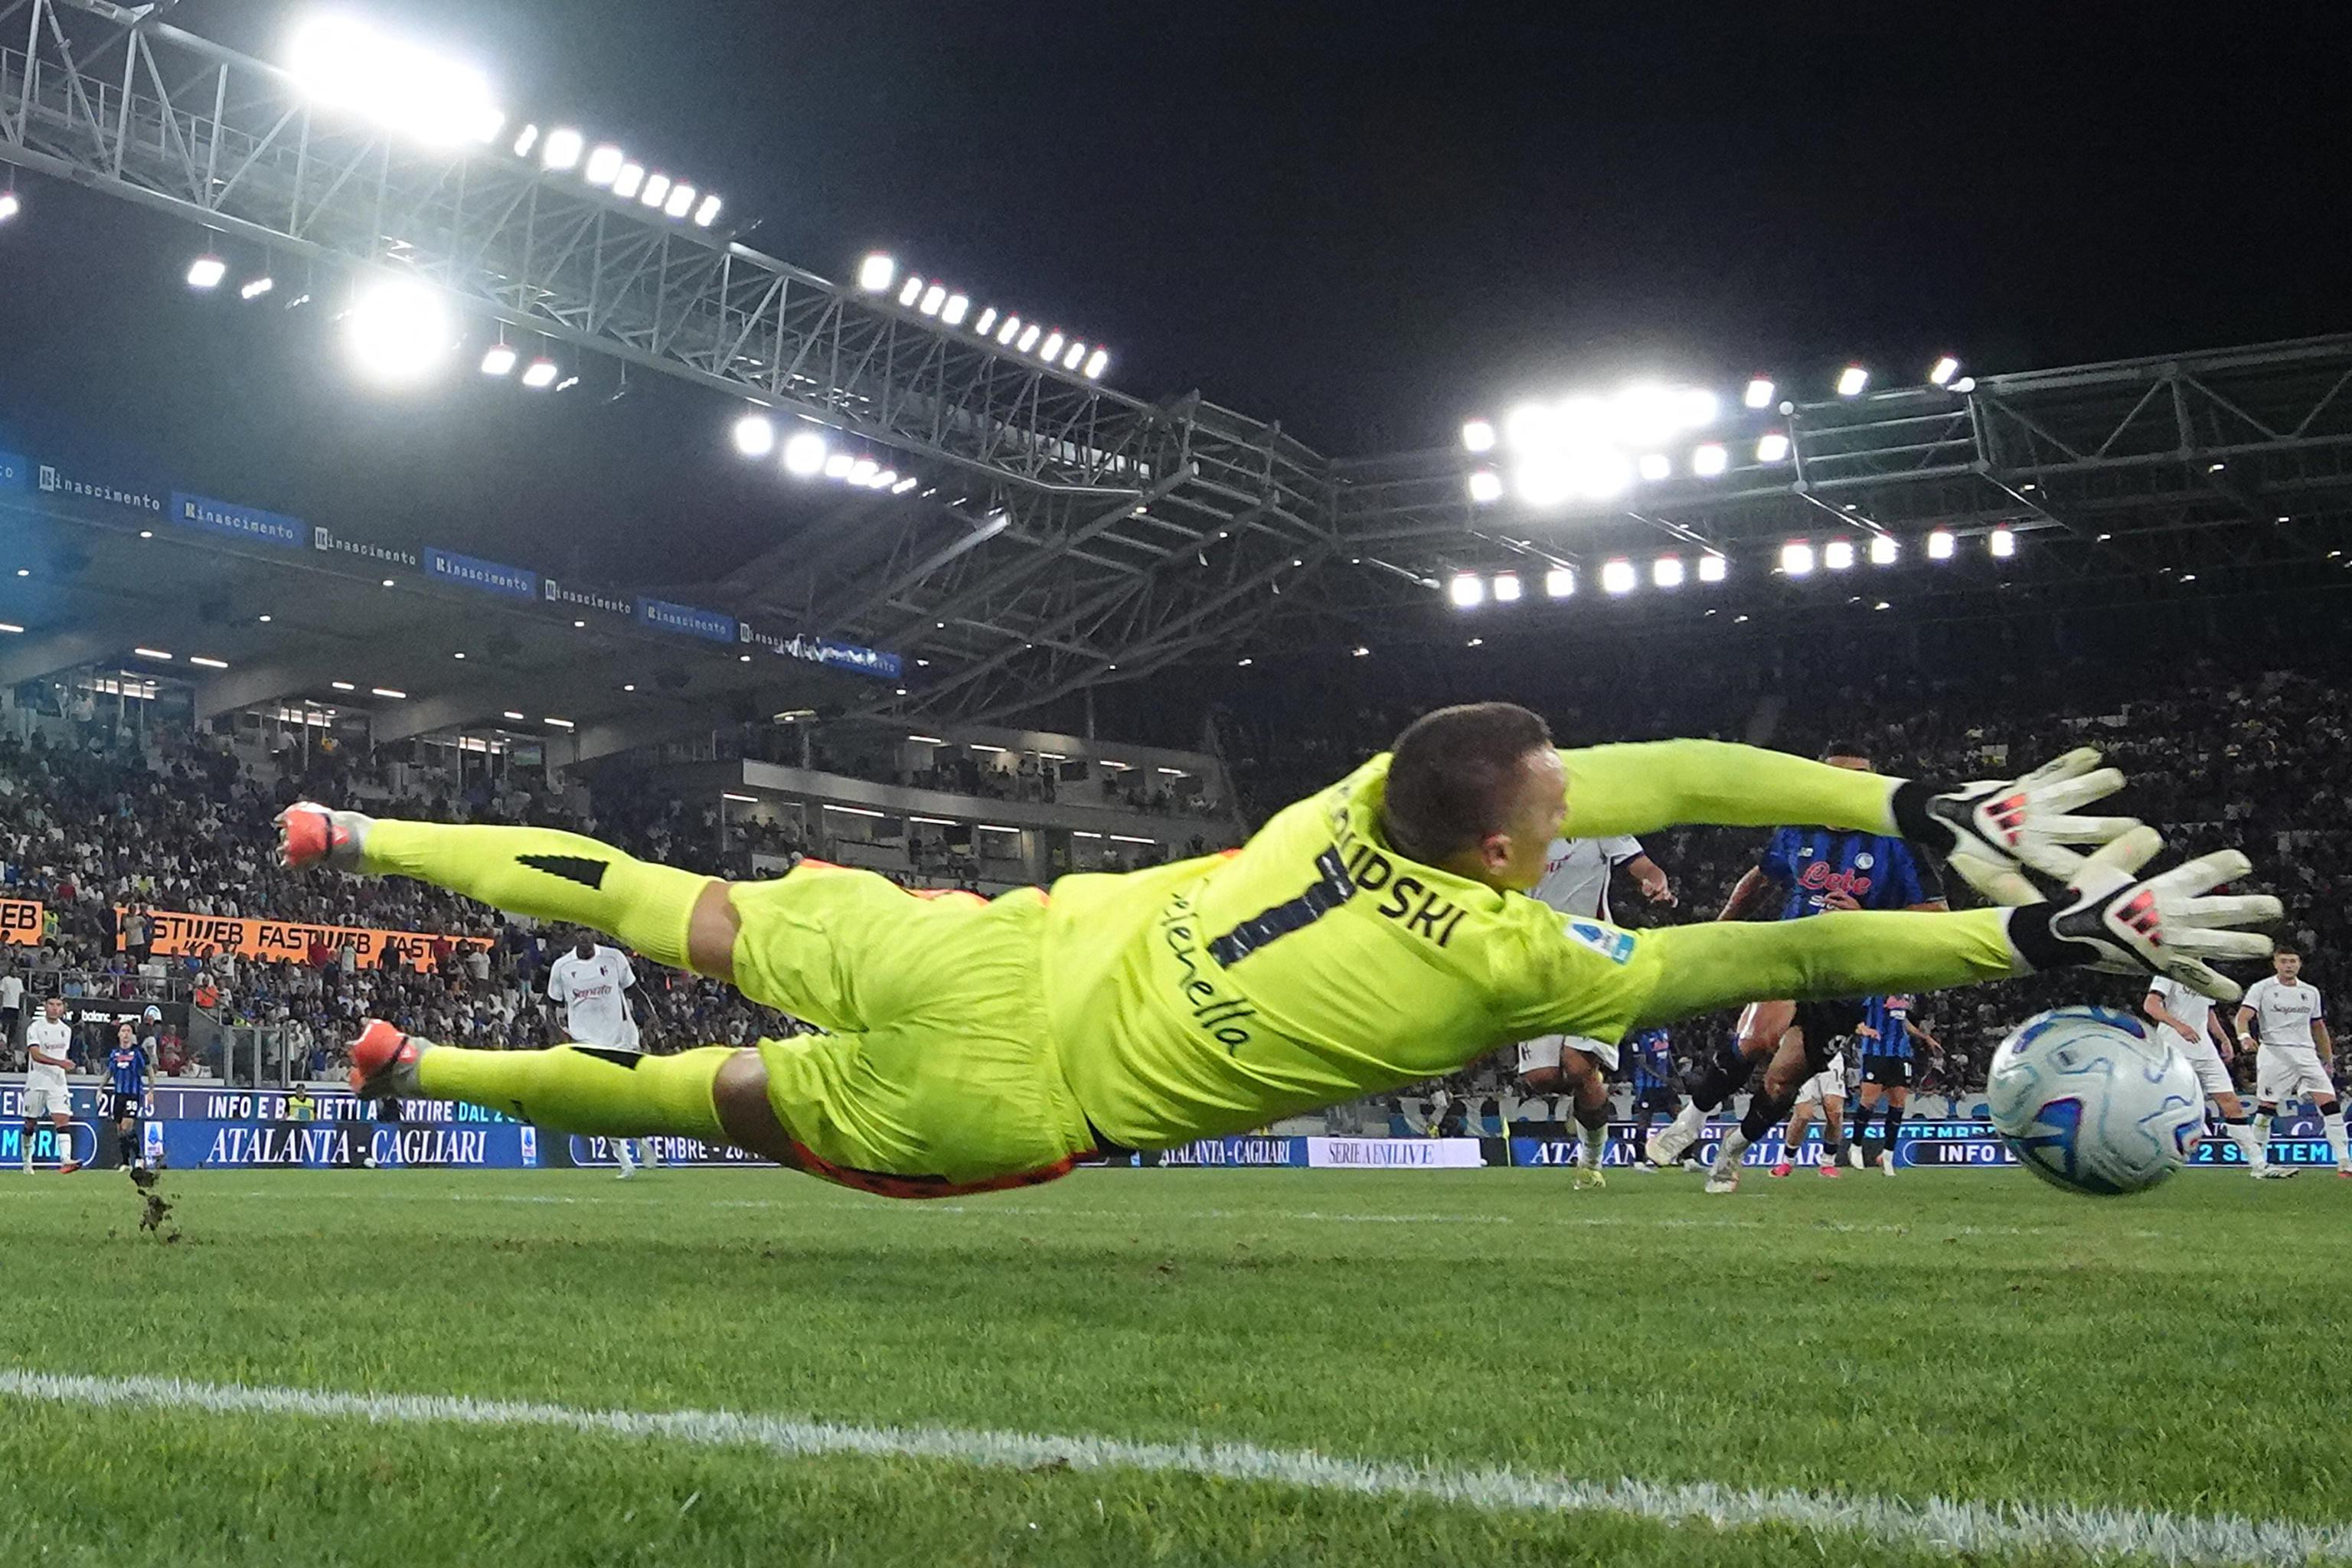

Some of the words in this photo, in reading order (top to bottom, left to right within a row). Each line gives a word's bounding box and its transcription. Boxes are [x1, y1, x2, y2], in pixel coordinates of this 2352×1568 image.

[40, 465, 160, 511] Rinascimento
[185, 502, 293, 539] Rinascimento
[315, 527, 416, 565] Rinascimento
[436, 557, 528, 591] Rinascimento
[1798, 861, 1872, 896] Lete
[1205, 845, 1357, 972] 1
[207, 1096, 251, 1119] INFO
[257, 1097, 270, 1119] E
[275, 1097, 361, 1120] BIETTI
[458, 1101, 489, 1122] DAL
[205, 1128, 351, 1164] ATALANTA
[371, 1129, 487, 1164] CAGLIARI
[590, 1136, 606, 1159] 12
[1161, 1140, 1225, 1164] ATALANTA
[1233, 1140, 1290, 1164] CAGLIARI
[1328, 1142, 1361, 1165] SERIE
[1939, 1145, 1995, 1162] INFO
